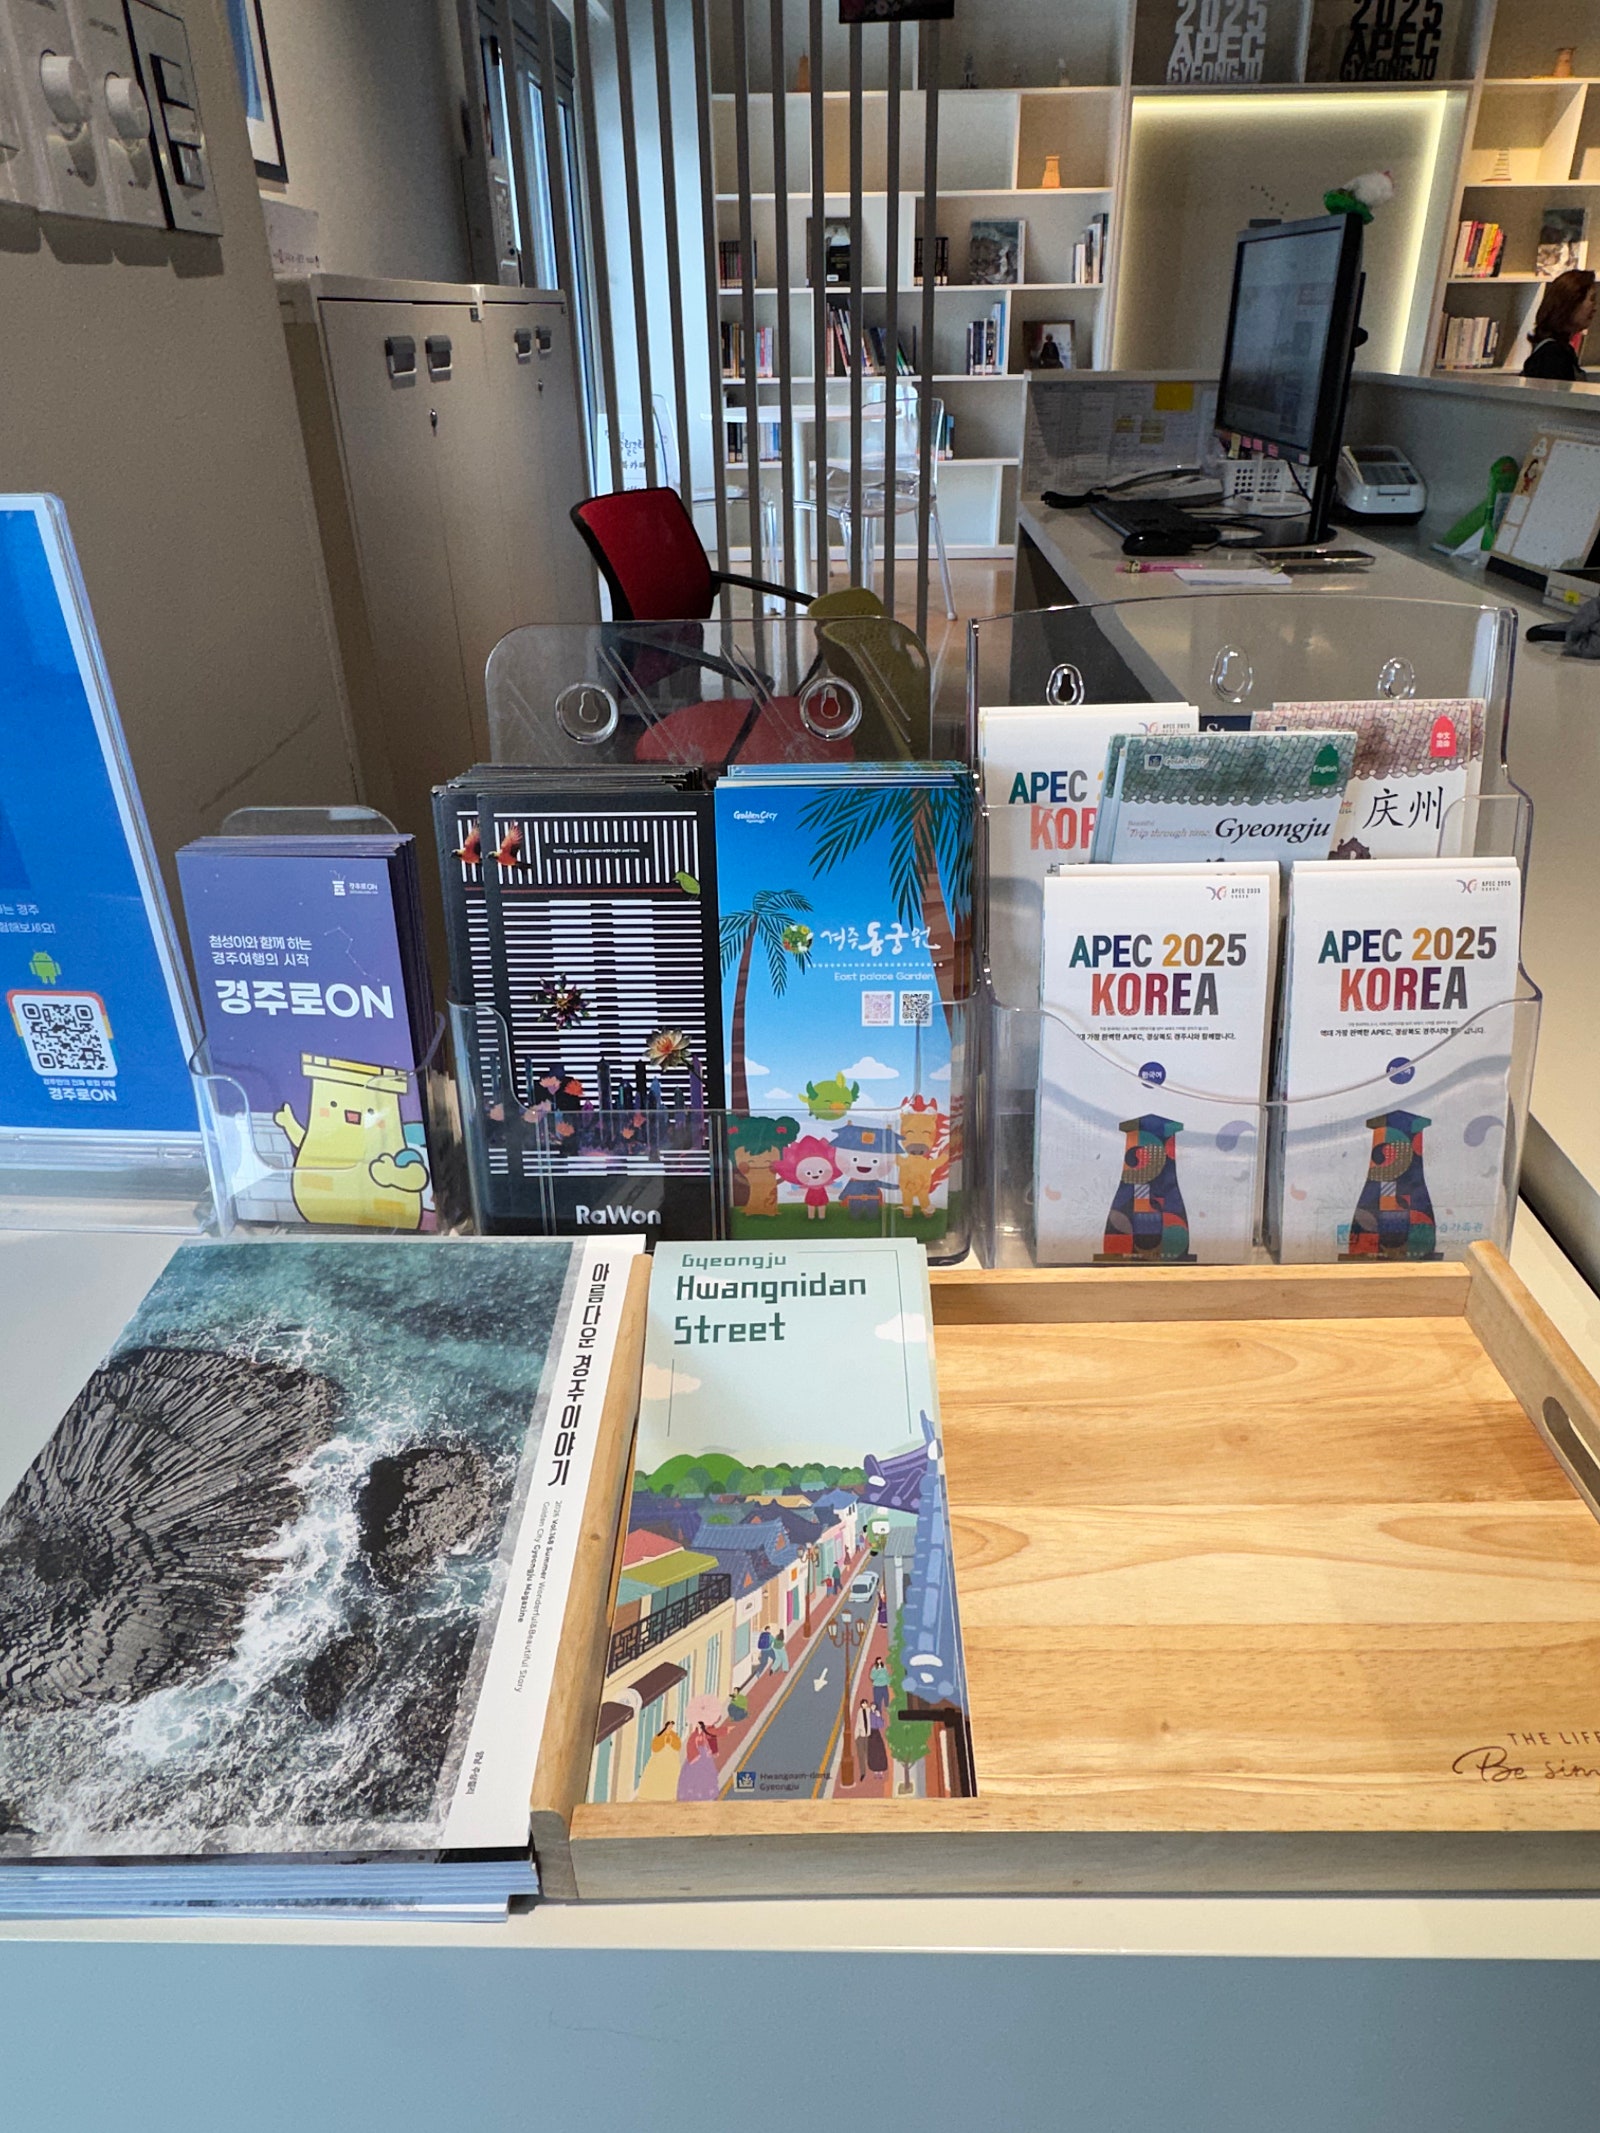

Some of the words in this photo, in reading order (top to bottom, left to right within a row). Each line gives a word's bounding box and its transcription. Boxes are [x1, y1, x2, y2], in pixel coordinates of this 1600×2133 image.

[1175, 0, 1268, 33] 2025
[1349, 0, 1444, 30] 2025
[1168, 31, 1267, 65] APEC
[1343, 25, 1441, 61] APEC
[1166, 61, 1265, 84] GYEONGJU
[1008, 770, 1088, 804] APEC
[1362, 787, 1444, 830] 庆州
[1215, 817, 1331, 843] Gyeongju
[209, 934, 258, 950] 첨성이와
[260, 936, 286, 950] 함께
[287, 937, 312, 951] 하는
[211, 951, 278, 966] 경주여행의
[283, 953, 309, 967] 시작
[1068, 934, 1152, 968] APEC
[1162, 933, 1247, 967] 2025
[1317, 928, 1402, 964] APEC
[1411, 926, 1497, 961] 2025
[834, 972, 857, 981] East
[859, 972, 894, 982] palace
[895, 971, 933, 981] Garden
[1339, 966, 1468, 1012] KOREA
[214, 979, 394, 1019] 경주로ON
[1091, 972, 1219, 1016] KOREA
[48, 1087, 118, 1102] 경주로ON
[575, 1204, 662, 1225] RaWon
[681, 1253, 786, 1270] Gyeongju
[676, 1272, 866, 1304] Hwangnidan
[578, 1262, 610, 1349] 아름다운
[673, 1312, 785, 1345] Street
[548, 1354, 592, 1487] 경주이야기
[541, 1546, 553, 1580] Summer
[517, 1583, 533, 1623] Magazine
[514, 1669, 528, 1693] Story
[1507, 1732, 1551, 1746] THE
[1452, 1745, 1528, 1782] Be
[759, 1783, 800, 1791] Gyeongju
